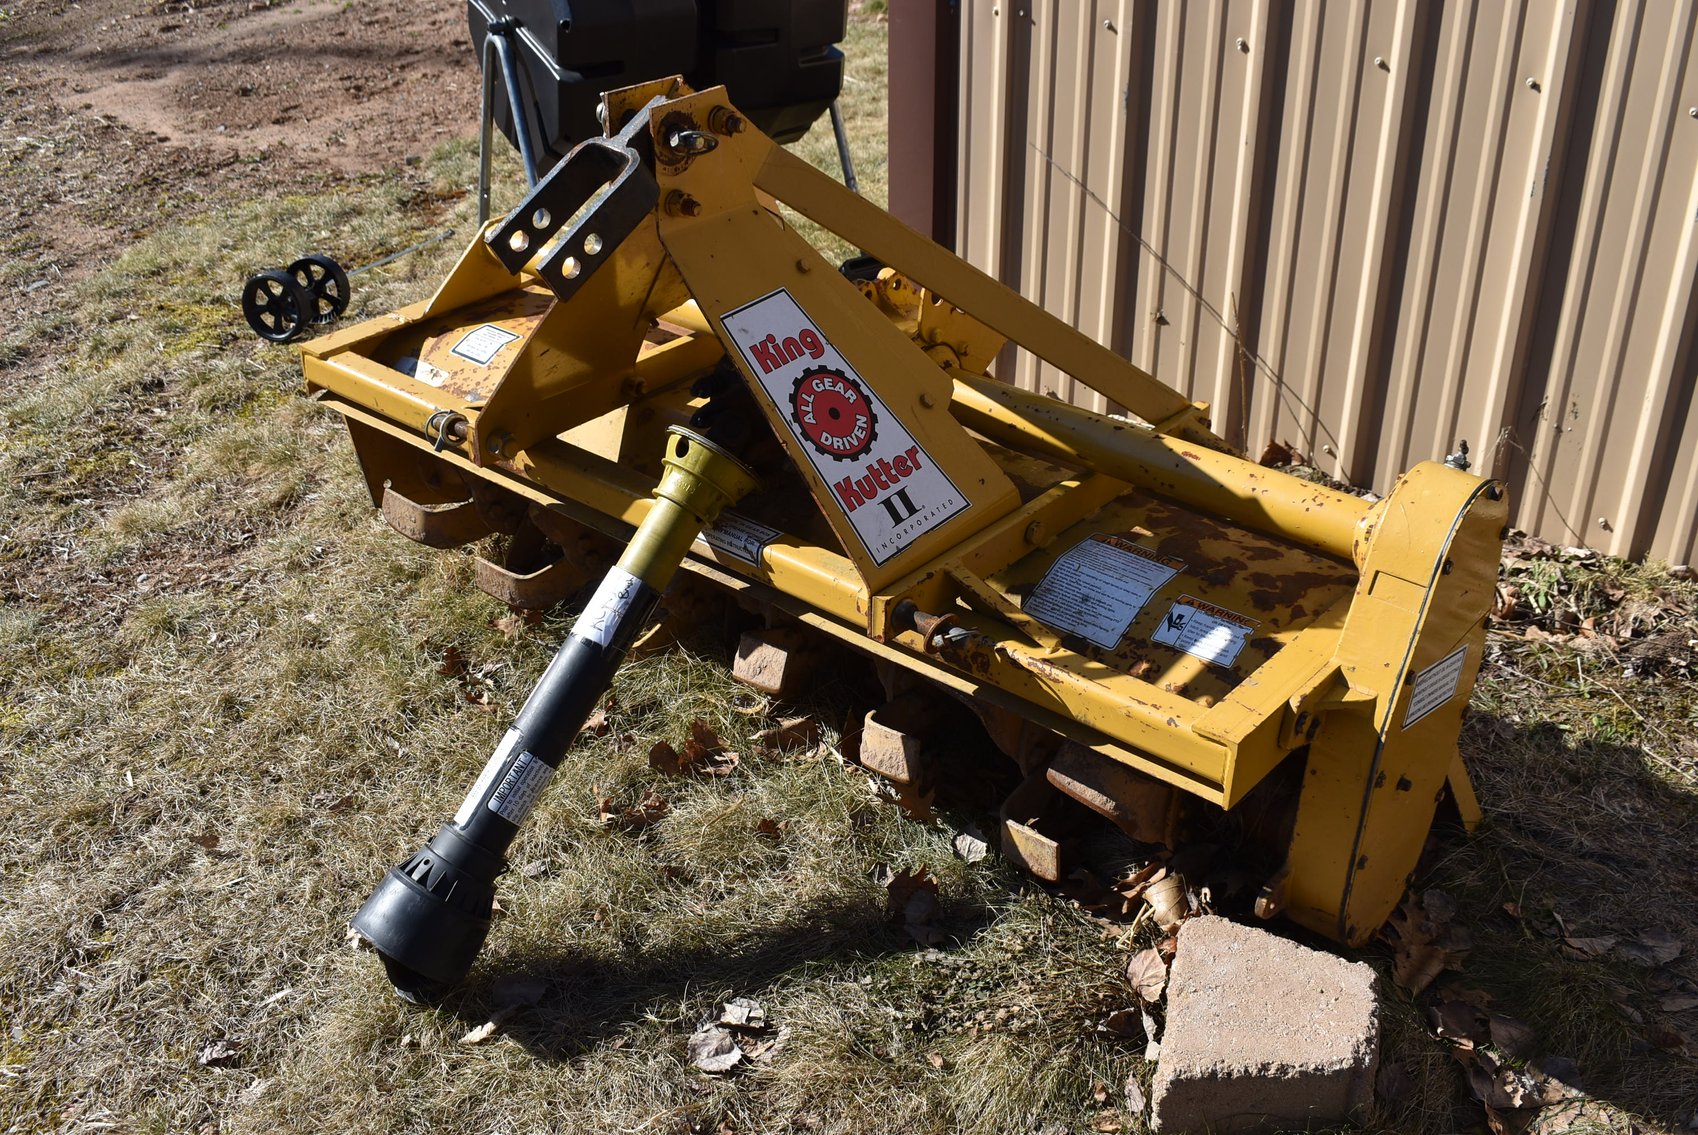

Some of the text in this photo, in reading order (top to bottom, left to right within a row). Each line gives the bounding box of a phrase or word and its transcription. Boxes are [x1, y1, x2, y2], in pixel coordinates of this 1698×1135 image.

[749, 328, 825, 375] King
[802, 377, 857, 425] ALL GEAR
[820, 414, 868, 451] DRIVEN
[833, 445, 922, 512] Kutter
[876, 498, 954, 553] INCORPORATED
[877, 485, 922, 529] II
[1113, 539, 1173, 567] WARNING
[493, 758, 526, 804] IMPORTANT
